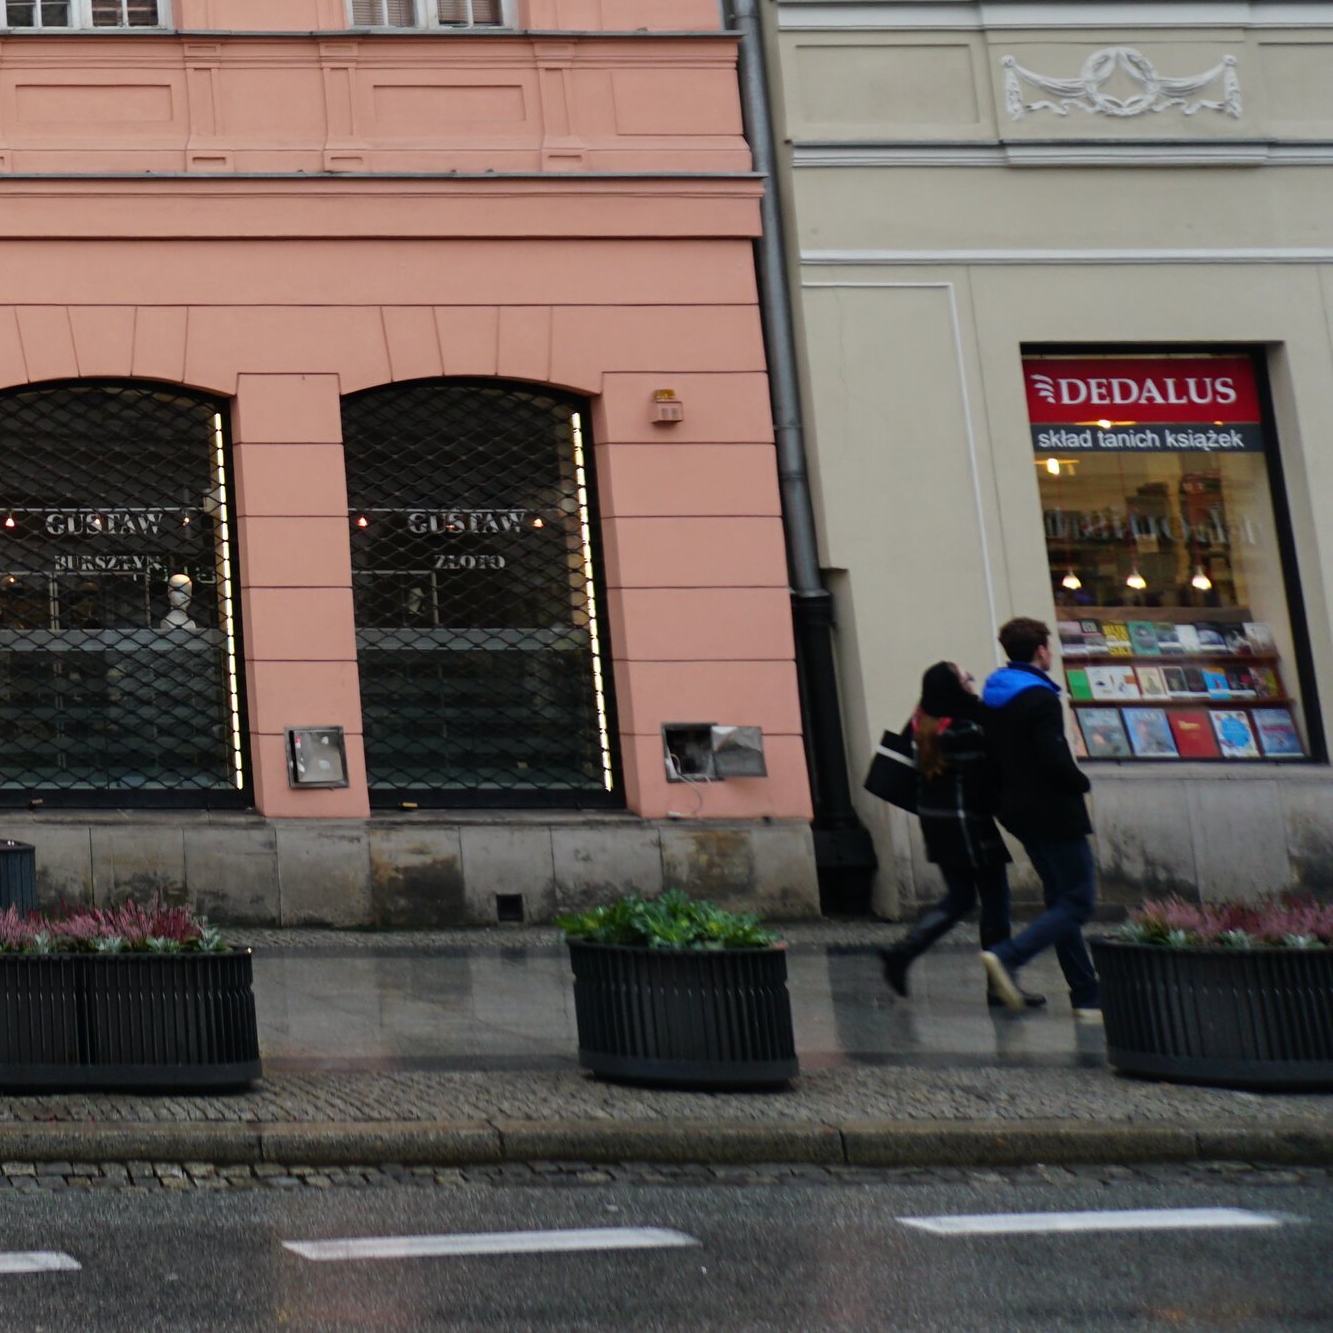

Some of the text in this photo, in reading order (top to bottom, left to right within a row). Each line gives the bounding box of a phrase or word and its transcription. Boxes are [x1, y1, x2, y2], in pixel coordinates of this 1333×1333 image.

[1057, 377, 1237, 405] DEDALUS
[1038, 429, 1245, 451] skład tanich książek
[45, 513, 163, 535] GUSTAW
[408, 512, 526, 534] GUSTAW
